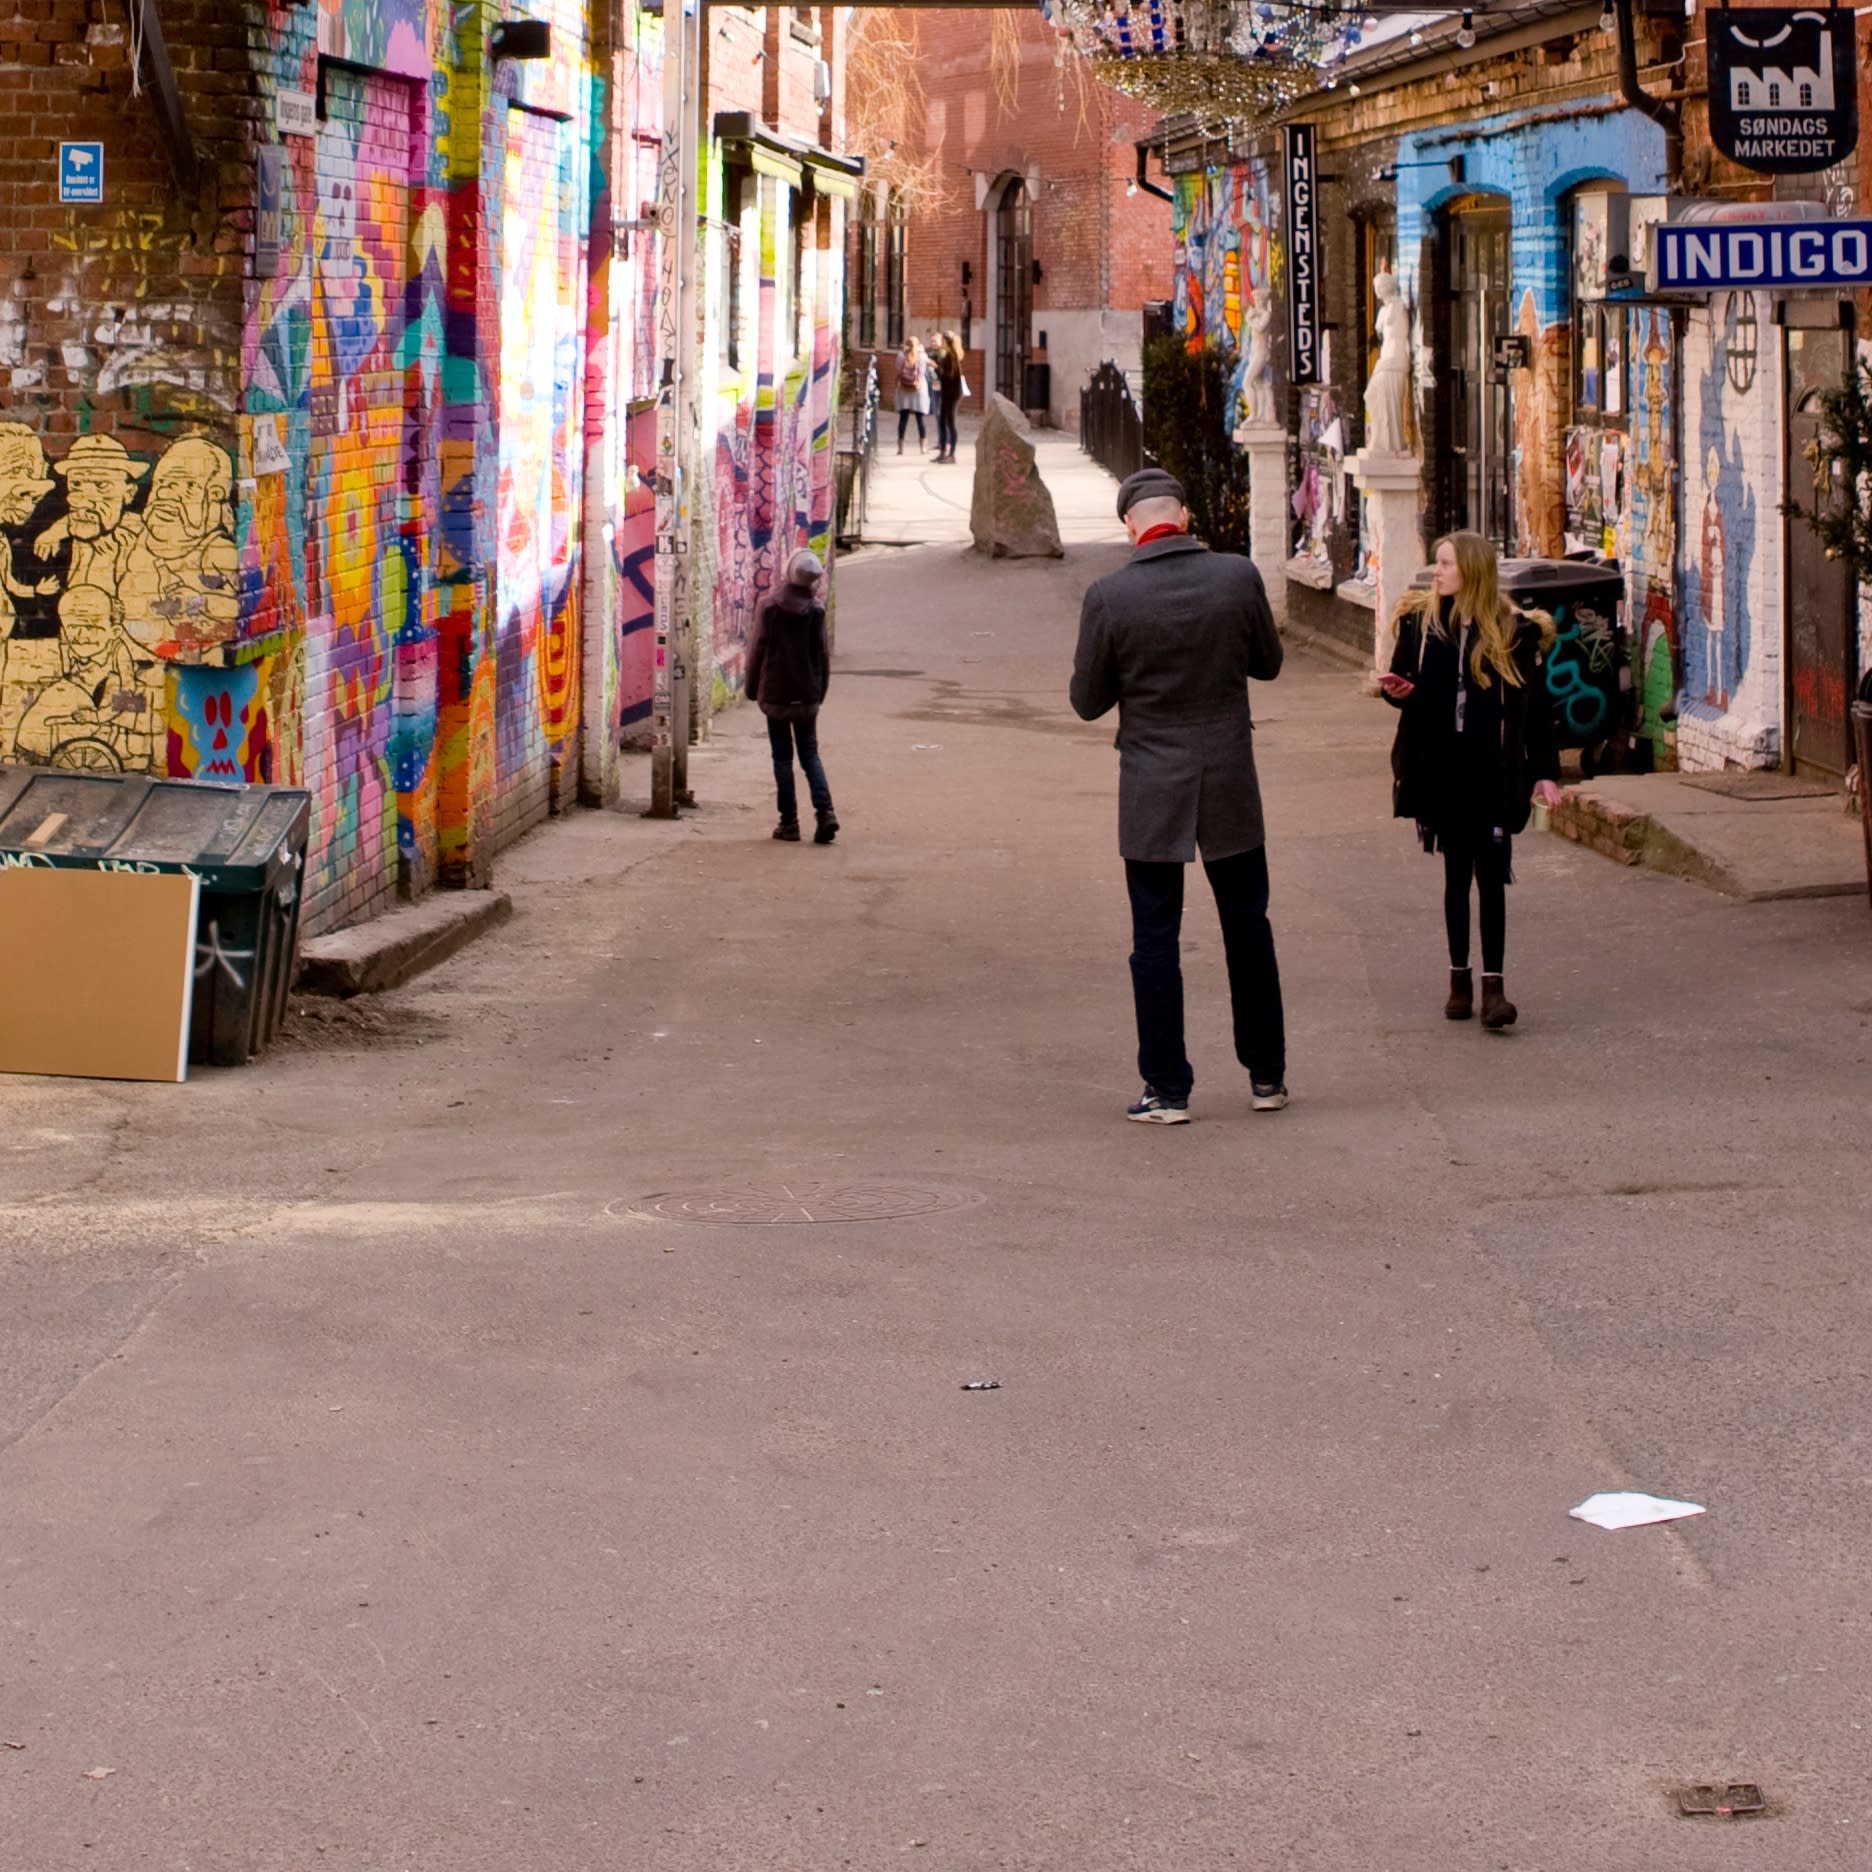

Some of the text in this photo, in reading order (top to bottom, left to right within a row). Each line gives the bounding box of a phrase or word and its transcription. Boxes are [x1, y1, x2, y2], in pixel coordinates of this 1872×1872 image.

[1739, 116, 1829, 137] SØNDAGS
[1734, 139, 1836, 158] MARKEDET
[1292, 132, 1313, 376] INGENSTEDS
[1666, 230, 1868, 280] INDIGO
